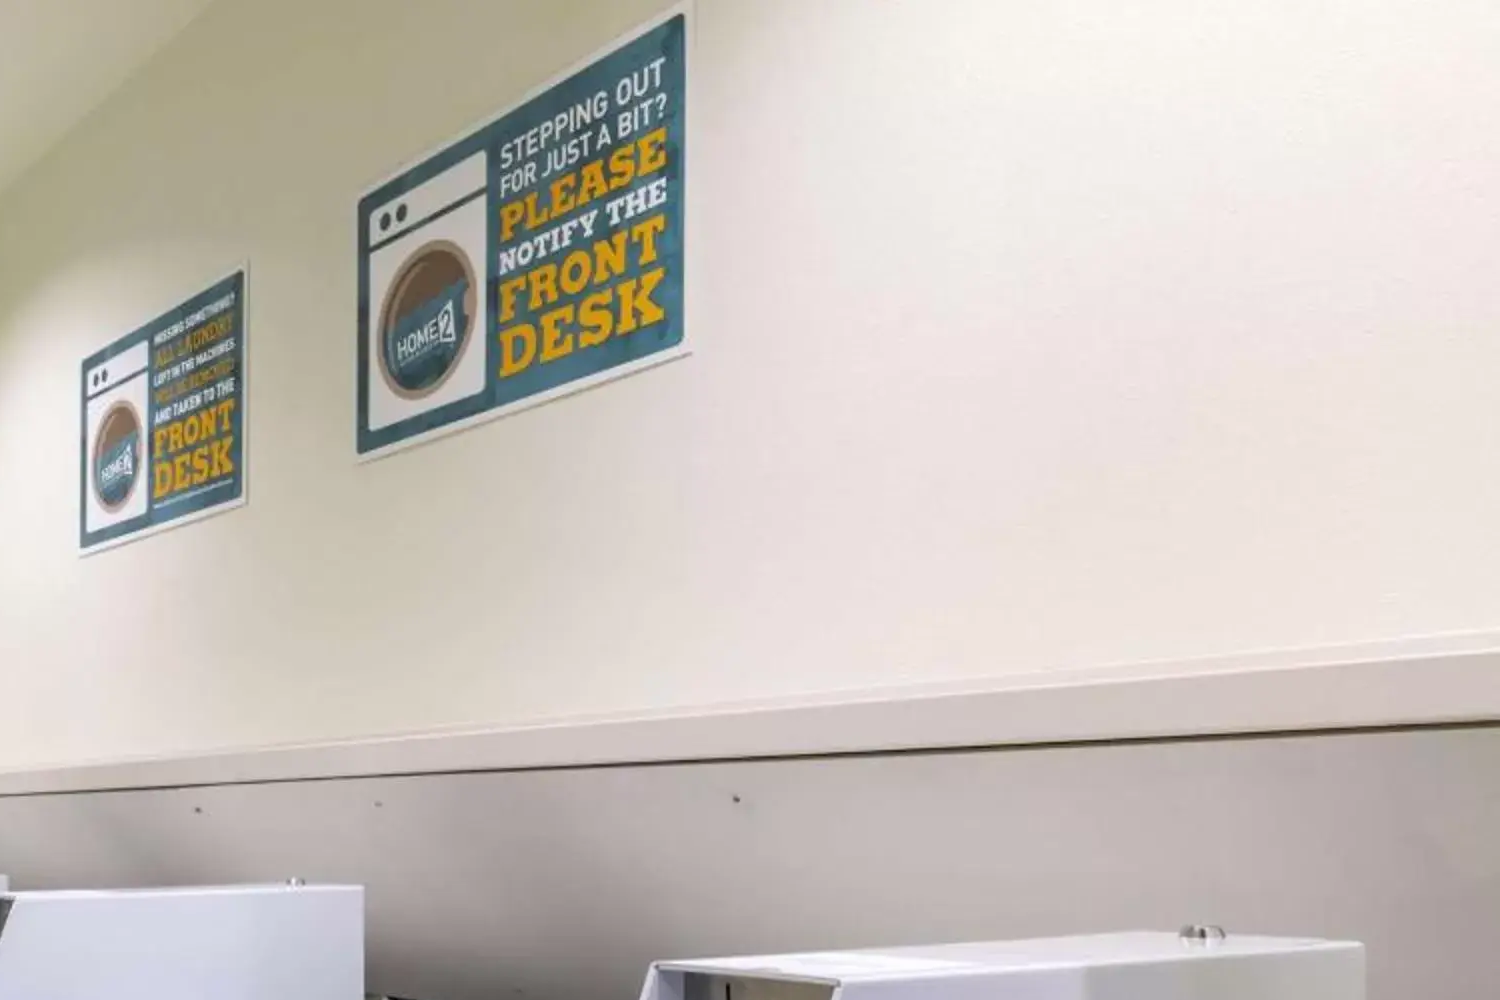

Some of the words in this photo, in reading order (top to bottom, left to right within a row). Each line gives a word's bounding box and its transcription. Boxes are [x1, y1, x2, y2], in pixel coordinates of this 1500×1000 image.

[501, 91, 609, 169] STEPPING
[616, 56, 666, 106] OUT
[501, 161, 537, 199] FOR
[541, 131, 593, 178] JUST
[597, 123, 612, 151] A
[618, 92, 668, 140] BIT?
[500, 208, 598, 276] NOTIFY
[606, 176, 667, 226] THE
[501, 127, 667, 242] PLEASE
[500, 213, 665, 323] FRONT
[500, 267, 665, 378] DESK
[154, 398, 235, 460] FRONT
[172, 392, 202, 417] TAKEN
[203, 387, 215, 404] TO
[215, 377, 235, 398] THE
[154, 435, 233, 498] DESK
